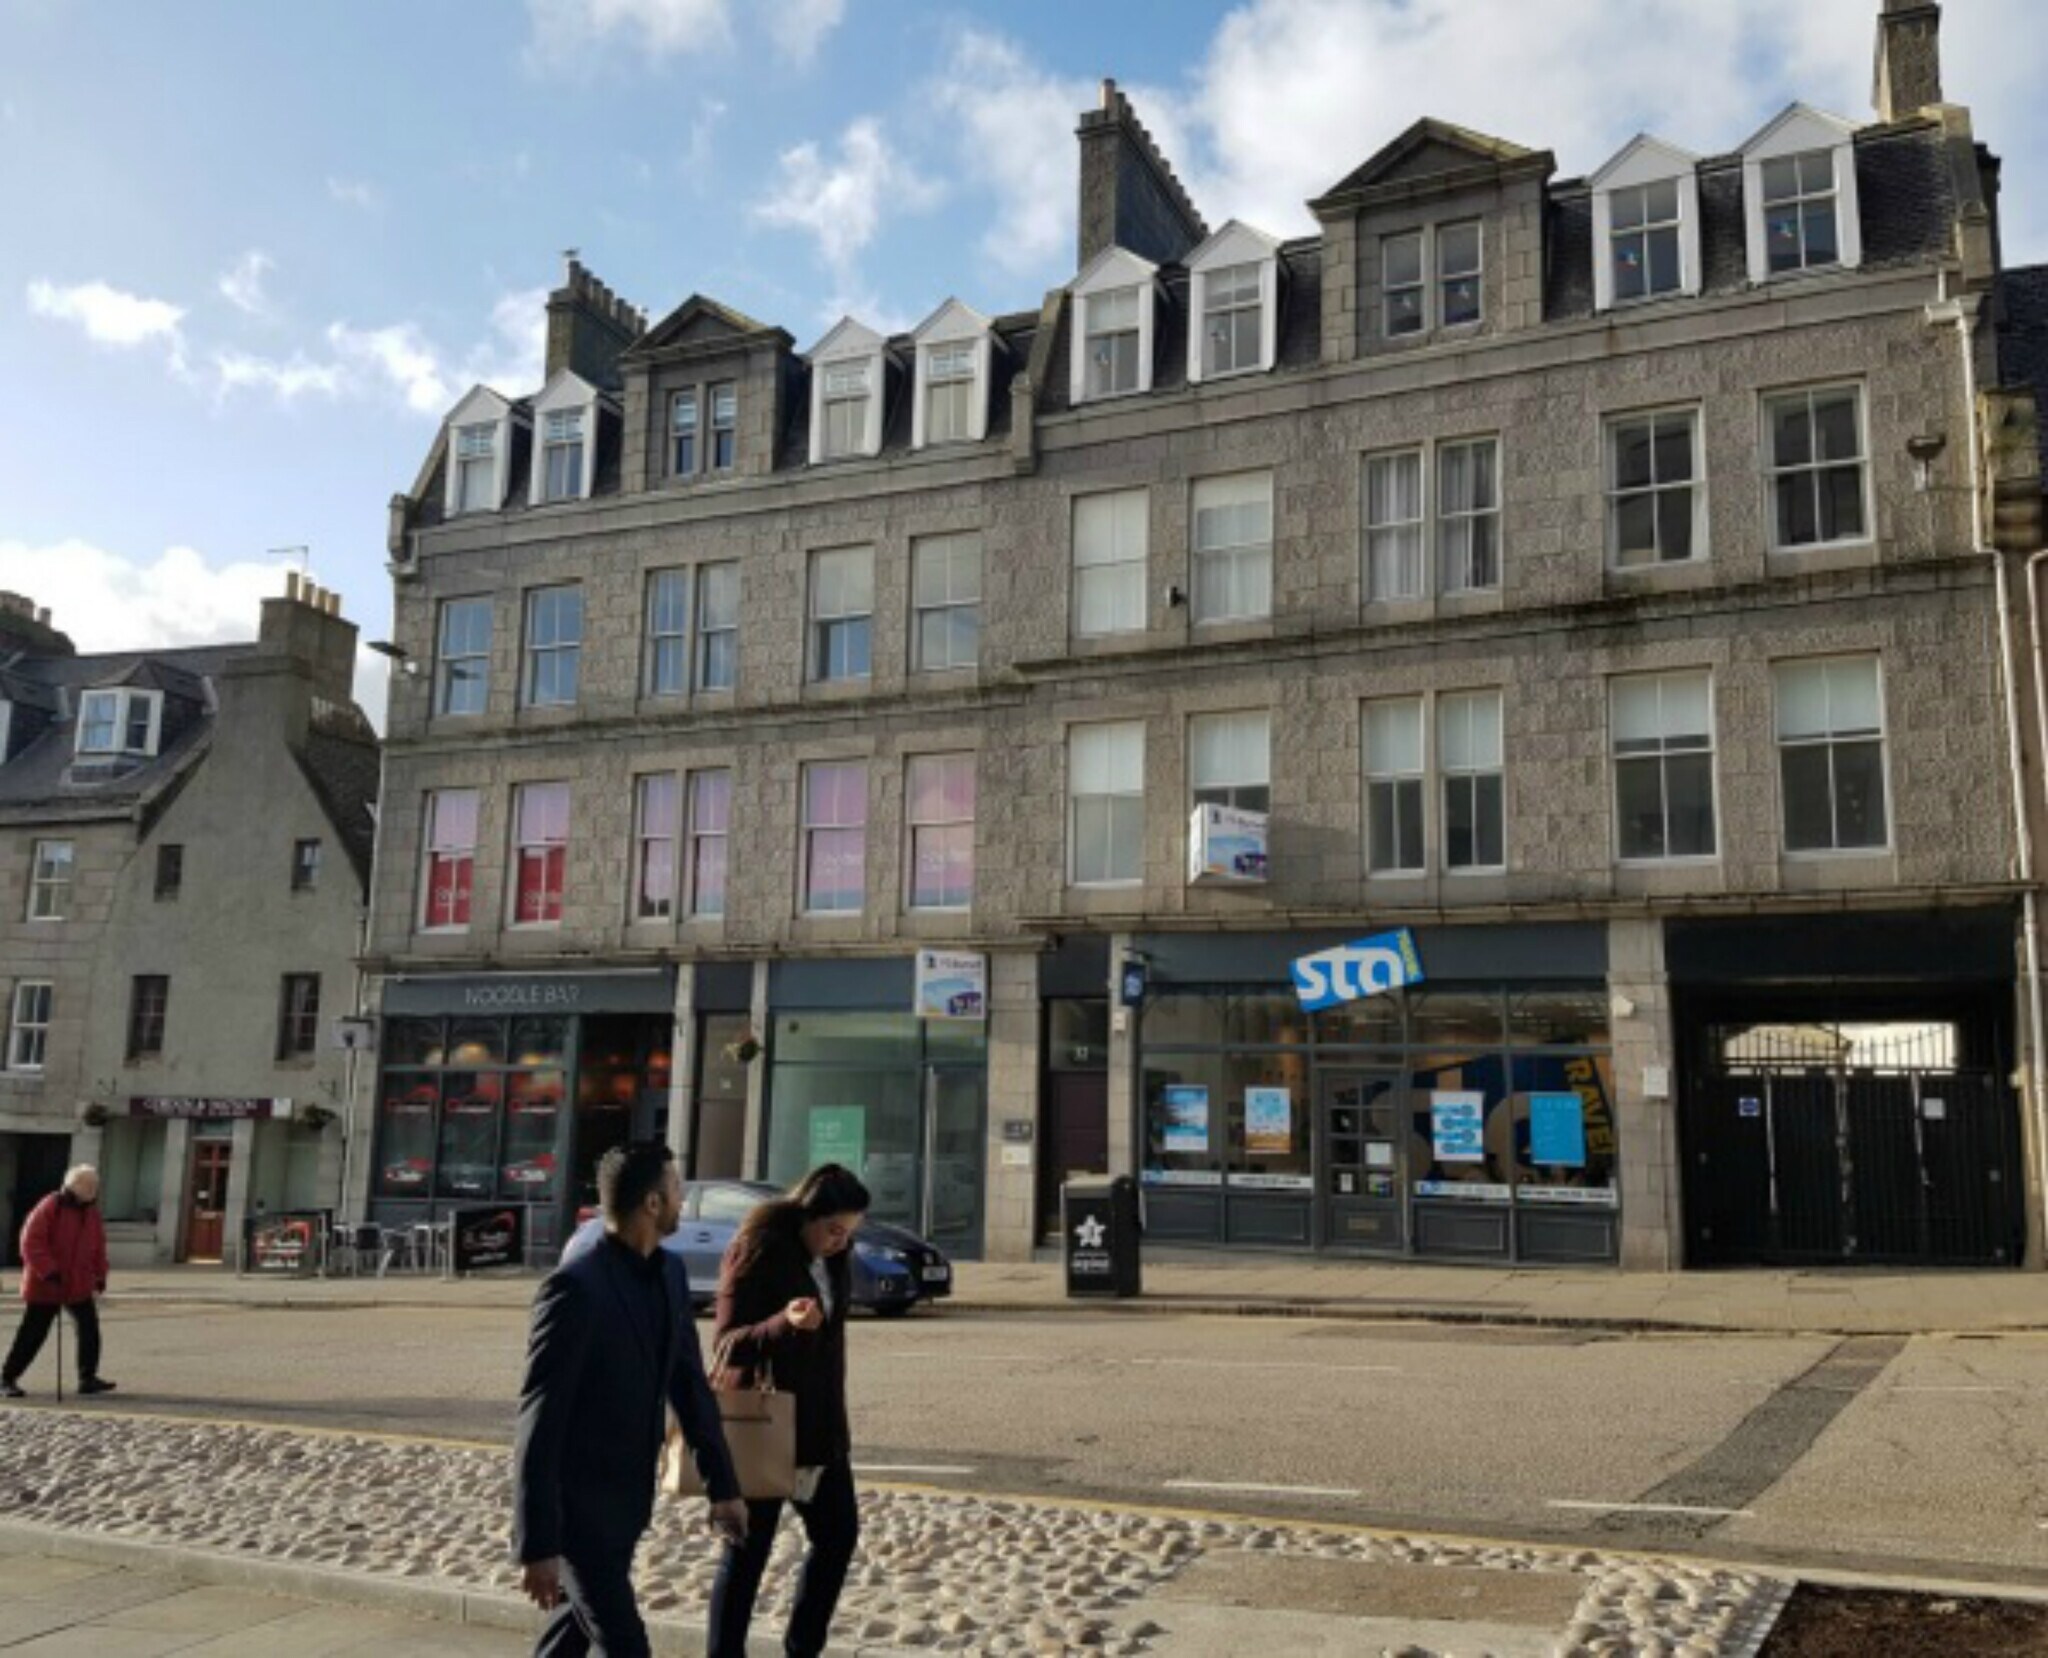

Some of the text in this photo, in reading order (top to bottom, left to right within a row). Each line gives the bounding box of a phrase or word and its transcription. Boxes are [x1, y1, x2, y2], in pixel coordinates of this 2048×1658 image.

[1296, 945, 1404, 999] sta
[465, 984, 579, 1005] NOODLE BAR
